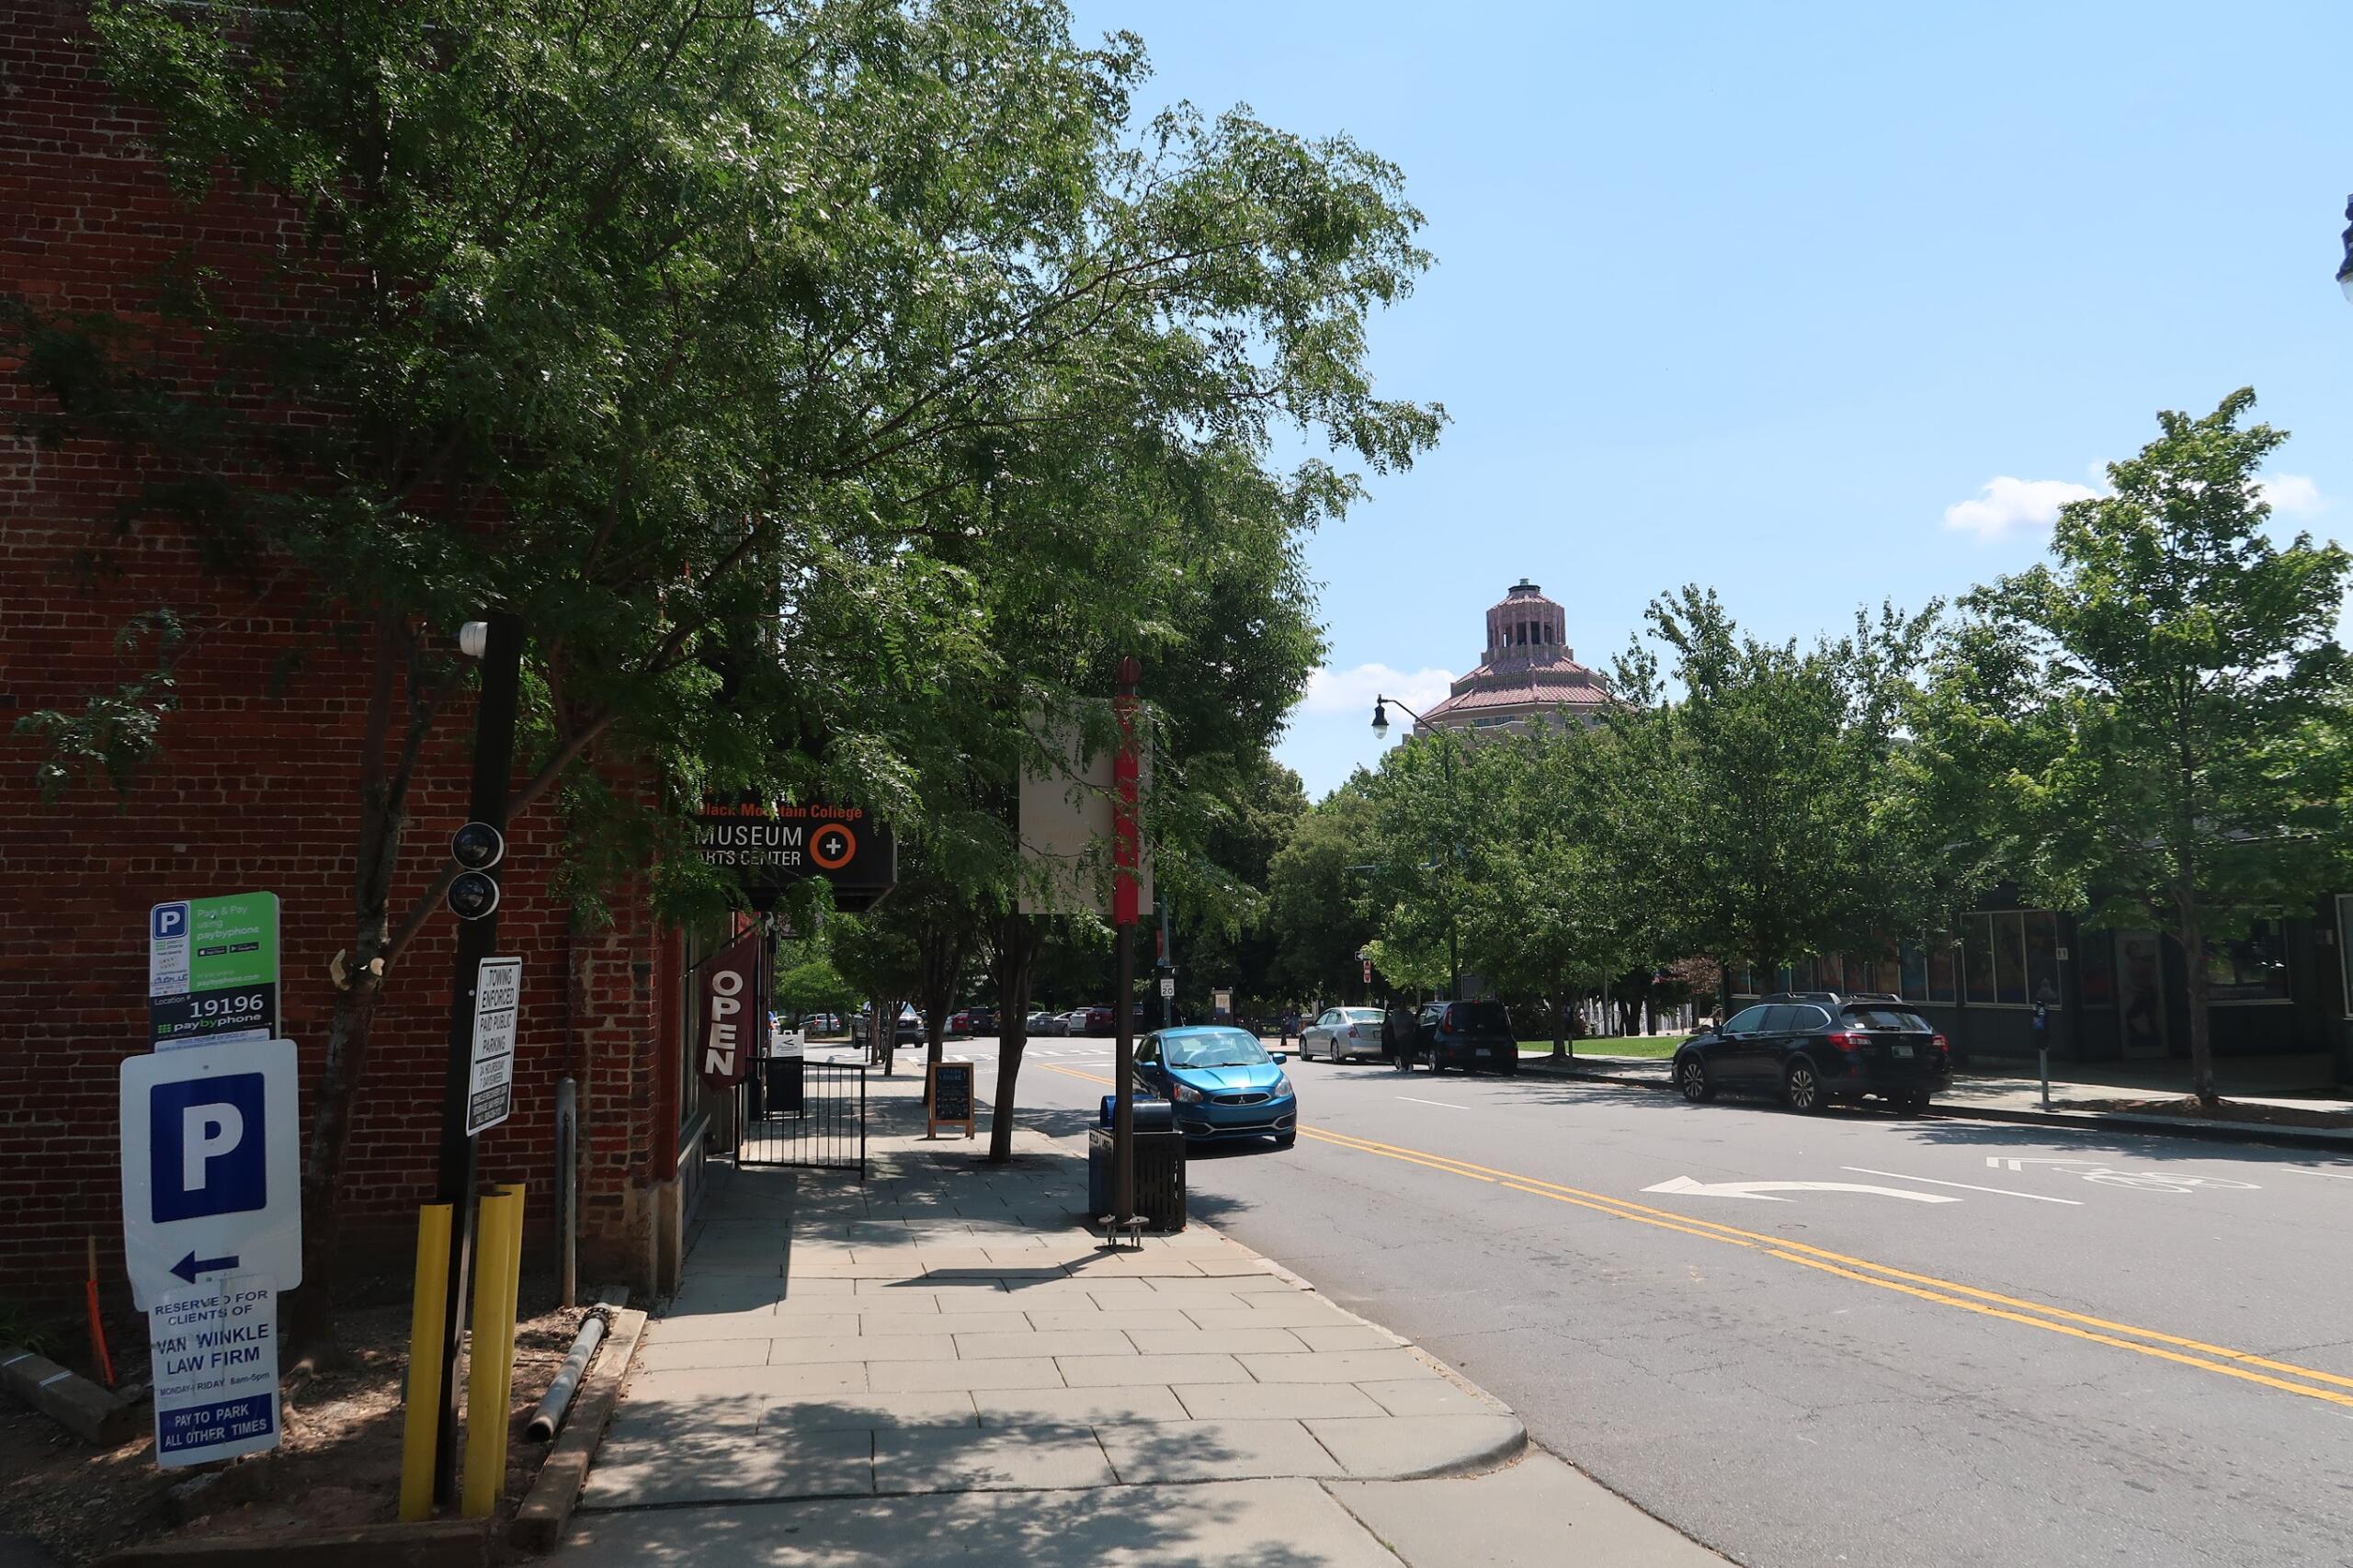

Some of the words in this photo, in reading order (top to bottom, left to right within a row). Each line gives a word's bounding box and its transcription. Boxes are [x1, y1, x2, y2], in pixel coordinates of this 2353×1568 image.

[741, 802, 806, 817] Motain
[811, 804, 862, 822] College
[695, 825, 801, 846] MUSEUM
[741, 850, 801, 866] CENTER
[162, 912, 180, 933] P
[198, 926, 259, 941] paybyphone
[489, 969, 512, 986] TOWING
[154, 996, 185, 1006] Location
[190, 994, 264, 1018] 19196
[483, 988, 514, 1008] ENFORCED
[174, 1014, 262, 1032] paybyphone
[480, 1016, 492, 1032] PAID
[494, 1014, 511, 1030] PUBLIC
[705, 971, 744, 1076] OPEN
[483, 1036, 506, 1054] PARKING
[184, 1103, 244, 1191] P
[155, 1296, 231, 1315] RESERVED
[236, 1290, 267, 1303] FOR
[168, 1308, 227, 1325] CLIENTS
[233, 1304, 253, 1315] OF
[156, 1336, 187, 1355] VAN
[196, 1324, 269, 1348] WINKLE
[167, 1355, 204, 1375] LAW
[211, 1346, 260, 1369] FIRM
[160, 1380, 224, 1396] MONDAY-RIDAY
[175, 1414, 191, 1427] PAY
[192, 1411, 210, 1425] TO
[216, 1403, 249, 1421] PARK
[165, 1434, 183, 1448] ALL
[186, 1426, 225, 1444] OTHER
[232, 1418, 267, 1436] TIMES
